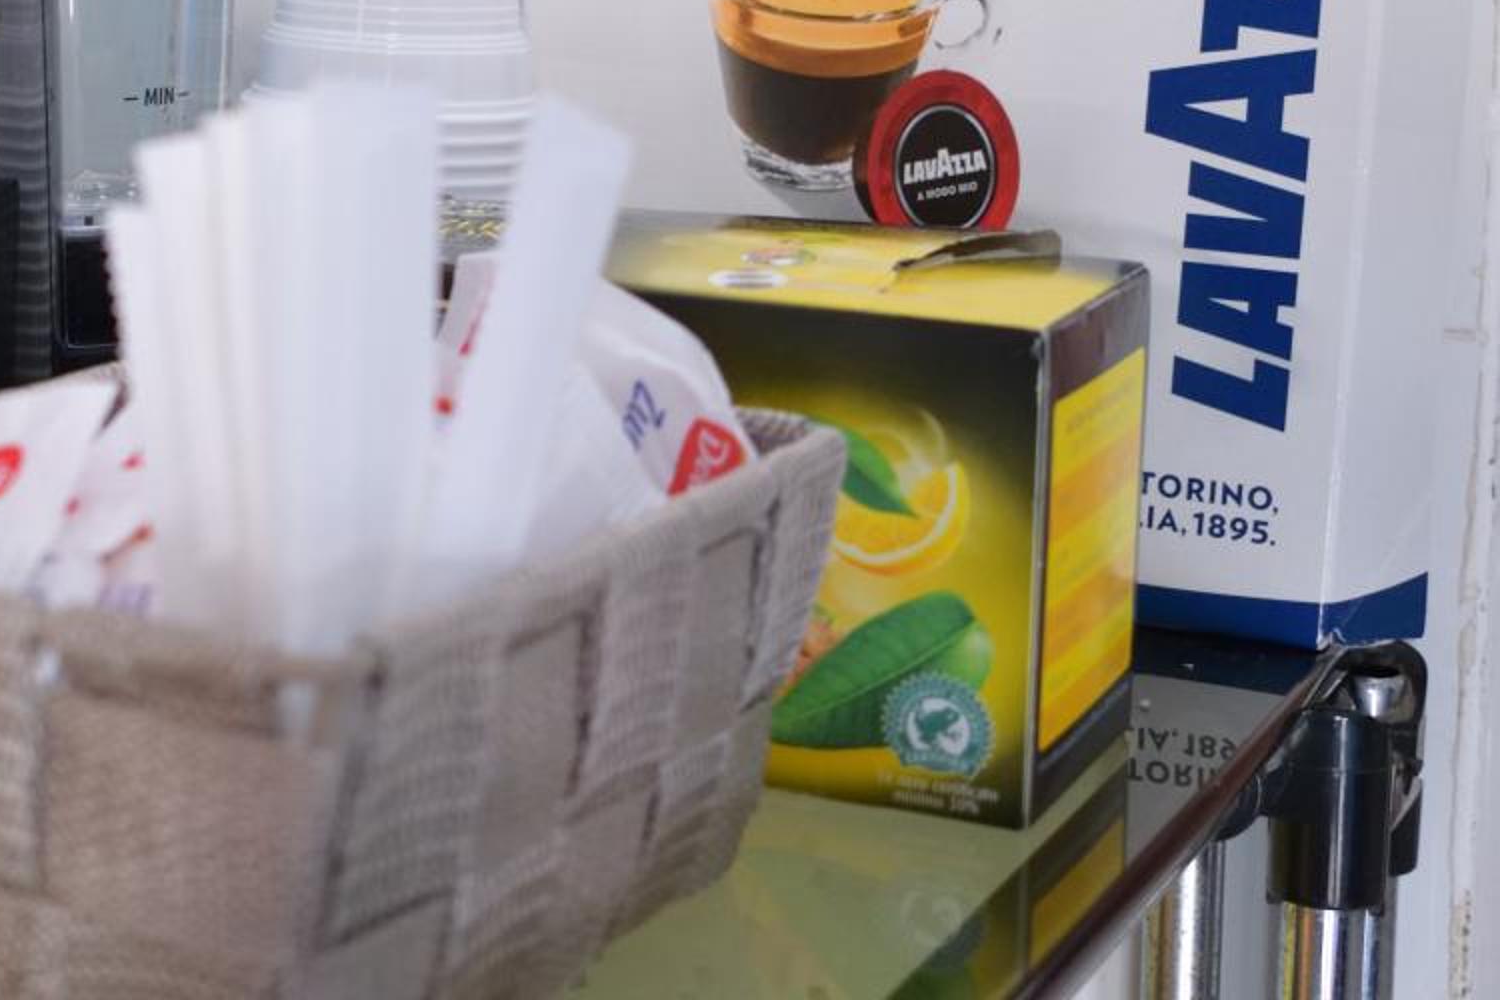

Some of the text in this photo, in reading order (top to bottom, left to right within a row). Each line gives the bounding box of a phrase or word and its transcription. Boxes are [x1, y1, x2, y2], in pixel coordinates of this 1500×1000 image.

[143, 87, 176, 106] MIN
[902, 147, 988, 186] LAVAZZA
[1141, 470, 1279, 515] TORINO,
[1139, 505, 1277, 547] IA, 1895.
